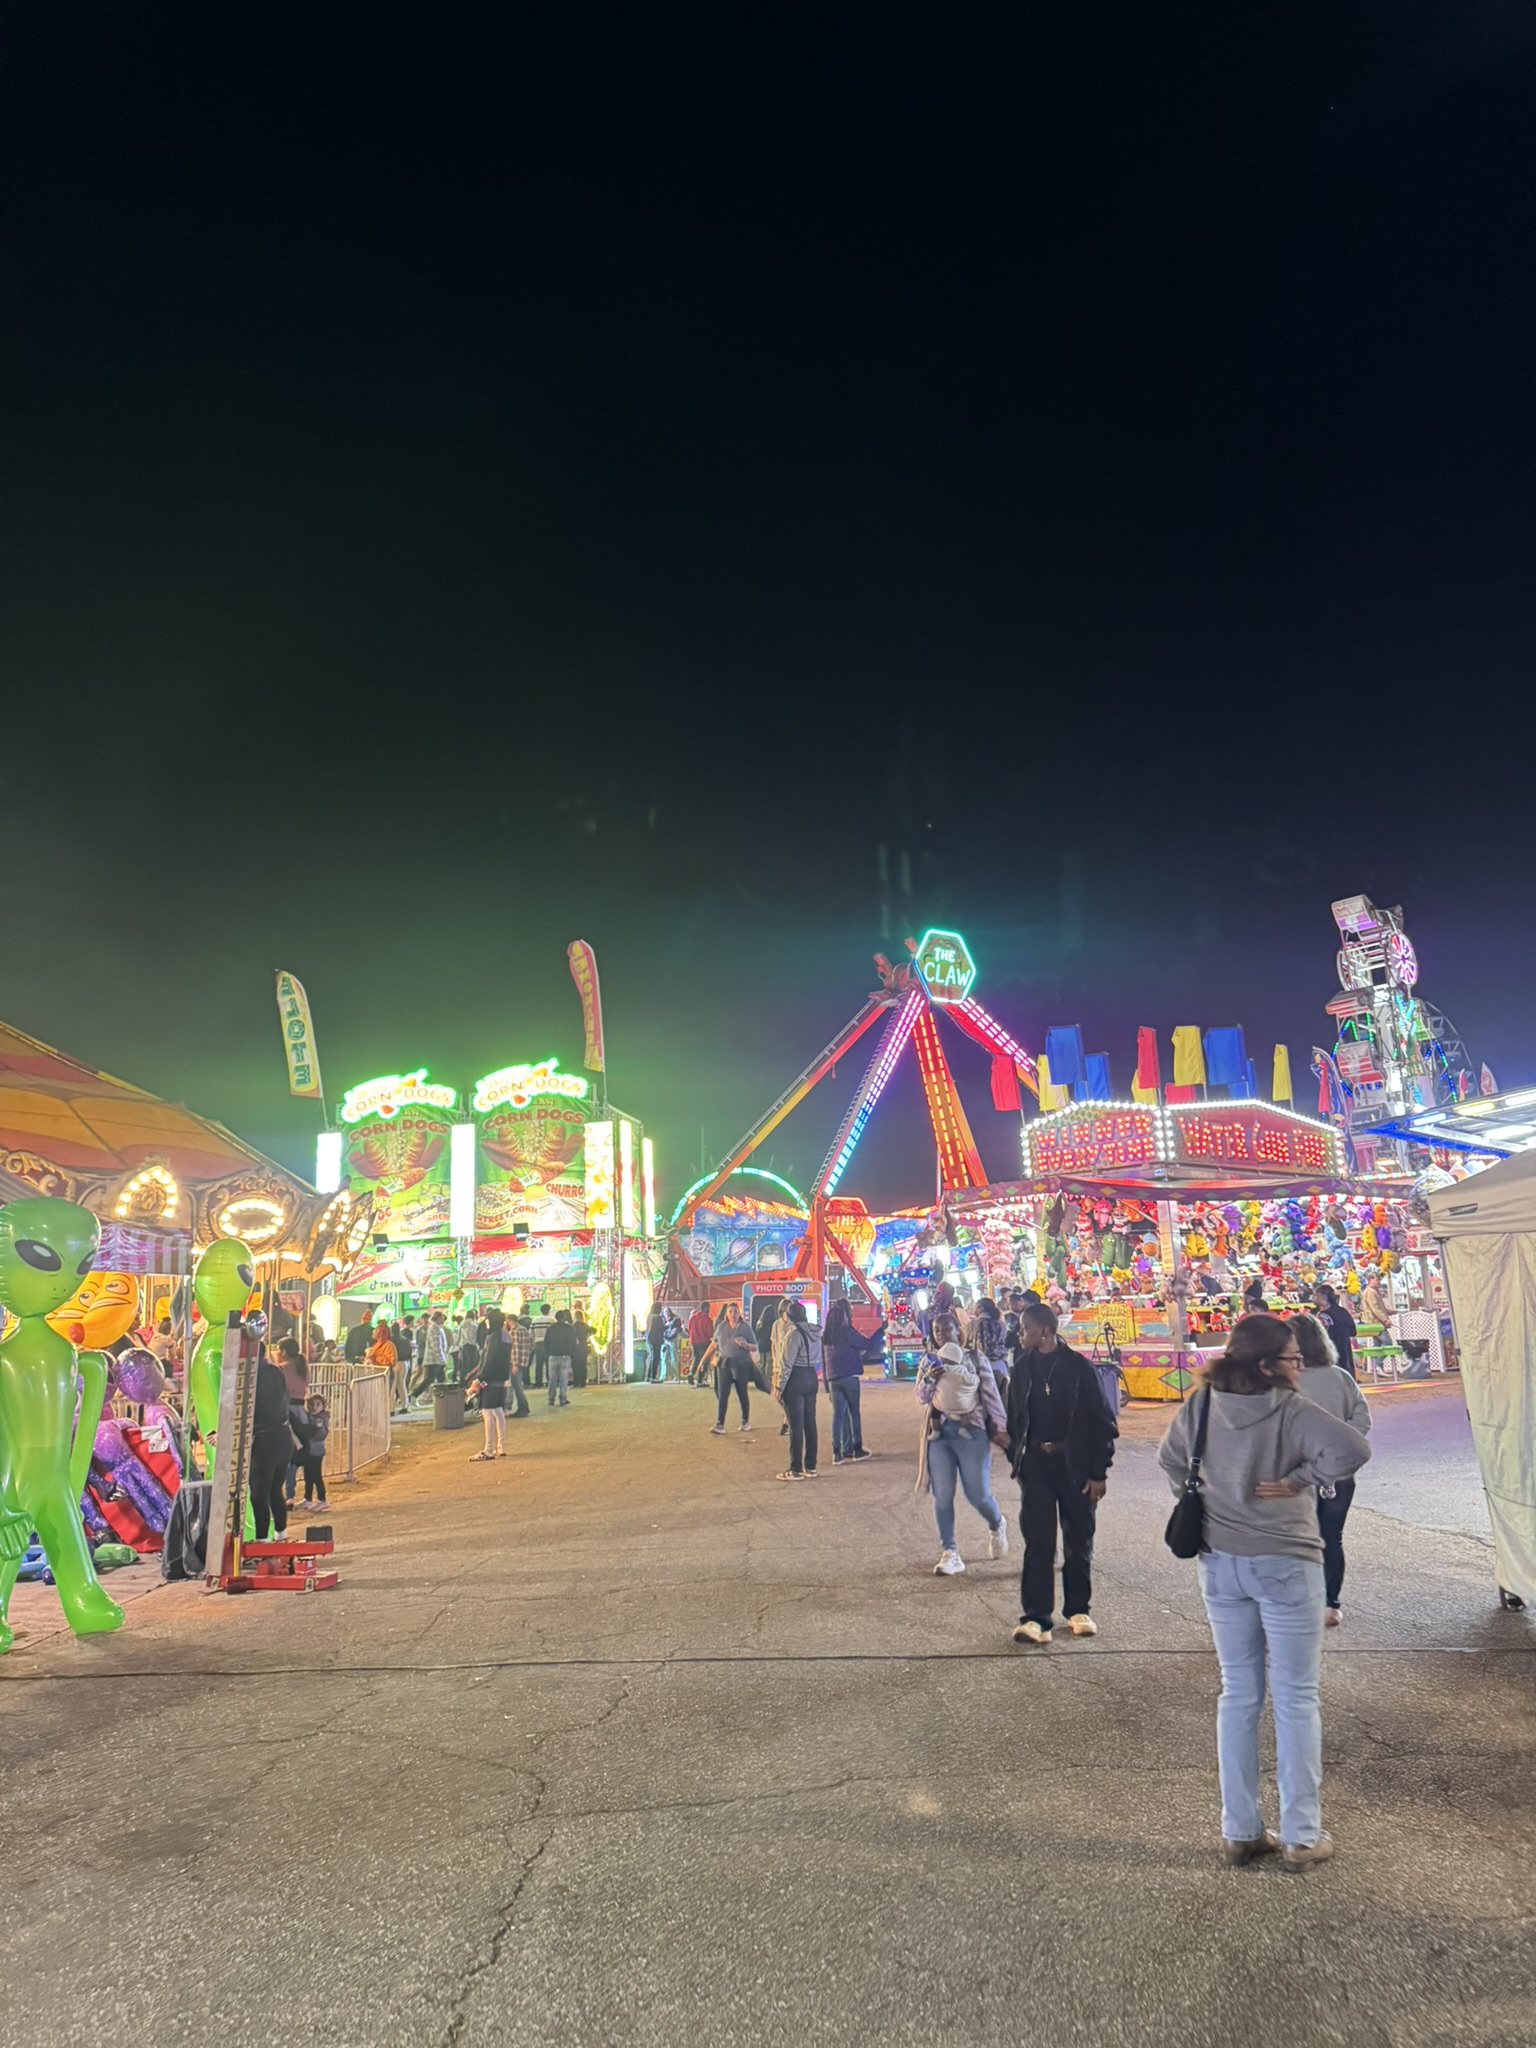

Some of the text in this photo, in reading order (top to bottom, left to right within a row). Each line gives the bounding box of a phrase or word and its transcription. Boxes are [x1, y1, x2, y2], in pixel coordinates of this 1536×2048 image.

[934, 947, 956, 963] THE
[923, 961, 971, 987] CLAW
[347, 1091, 392, 1117] CORN
[404, 1087, 451, 1104] DOGS
[479, 1081, 523, 1106] CORN
[536, 1077, 583, 1094] DOGS
[349, 1119, 448, 1142] CORN DOGS
[483, 1108, 584, 1130] CORN DOGS
[1035, 1113, 1153, 1149] WINNER
[1178, 1115, 1248, 1160] WATER
[1252, 1119, 1290, 1164] GUN
[512, 1205, 538, 1215] CORN
[834, 1215, 857, 1228] THE
[756, 1284, 814, 1292] PHOTO BOOTH
